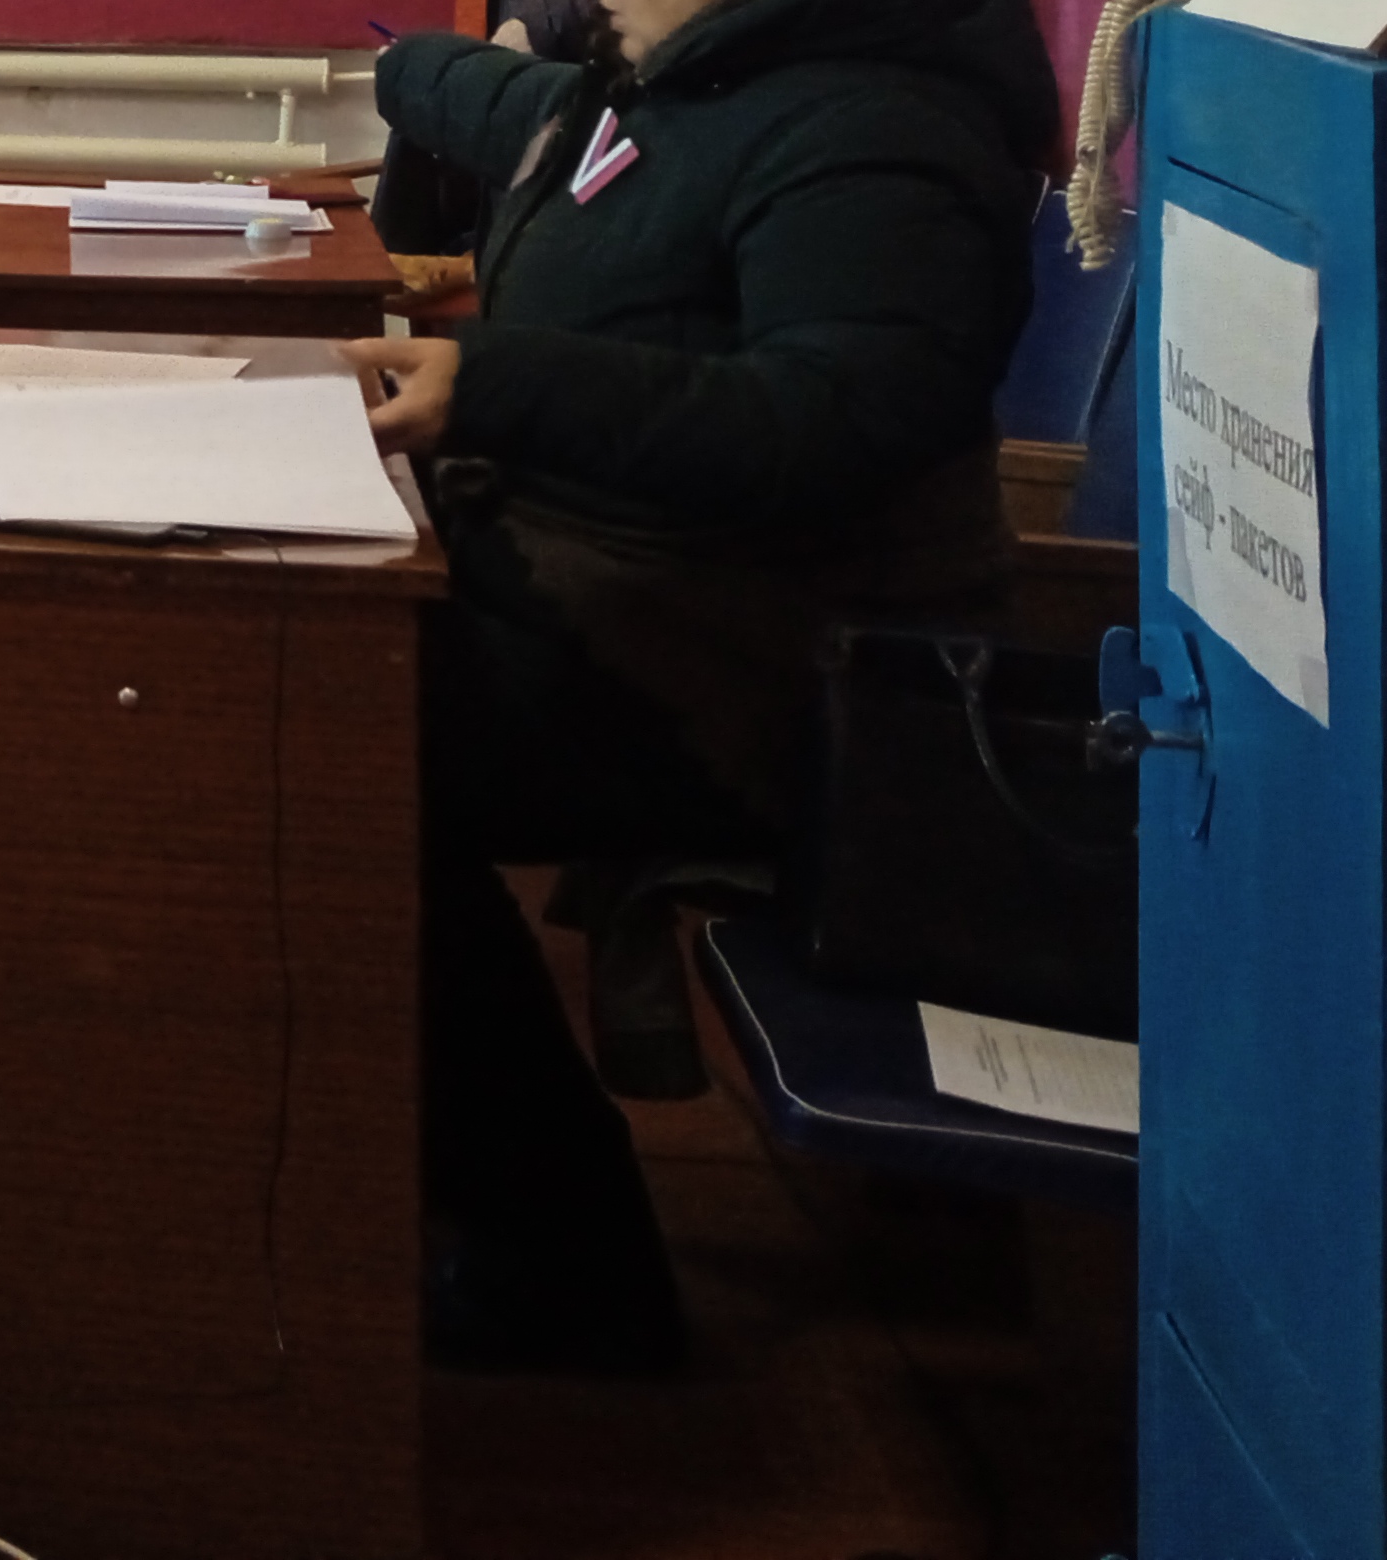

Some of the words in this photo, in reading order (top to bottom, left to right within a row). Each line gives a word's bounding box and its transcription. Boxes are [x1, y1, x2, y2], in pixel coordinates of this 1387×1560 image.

[1165, 339, 1216, 435] Место
[1221, 393, 1315, 499] хранения
[1174, 457, 1216, 551] сейф
[1229, 503, 1307, 603] пакетов
